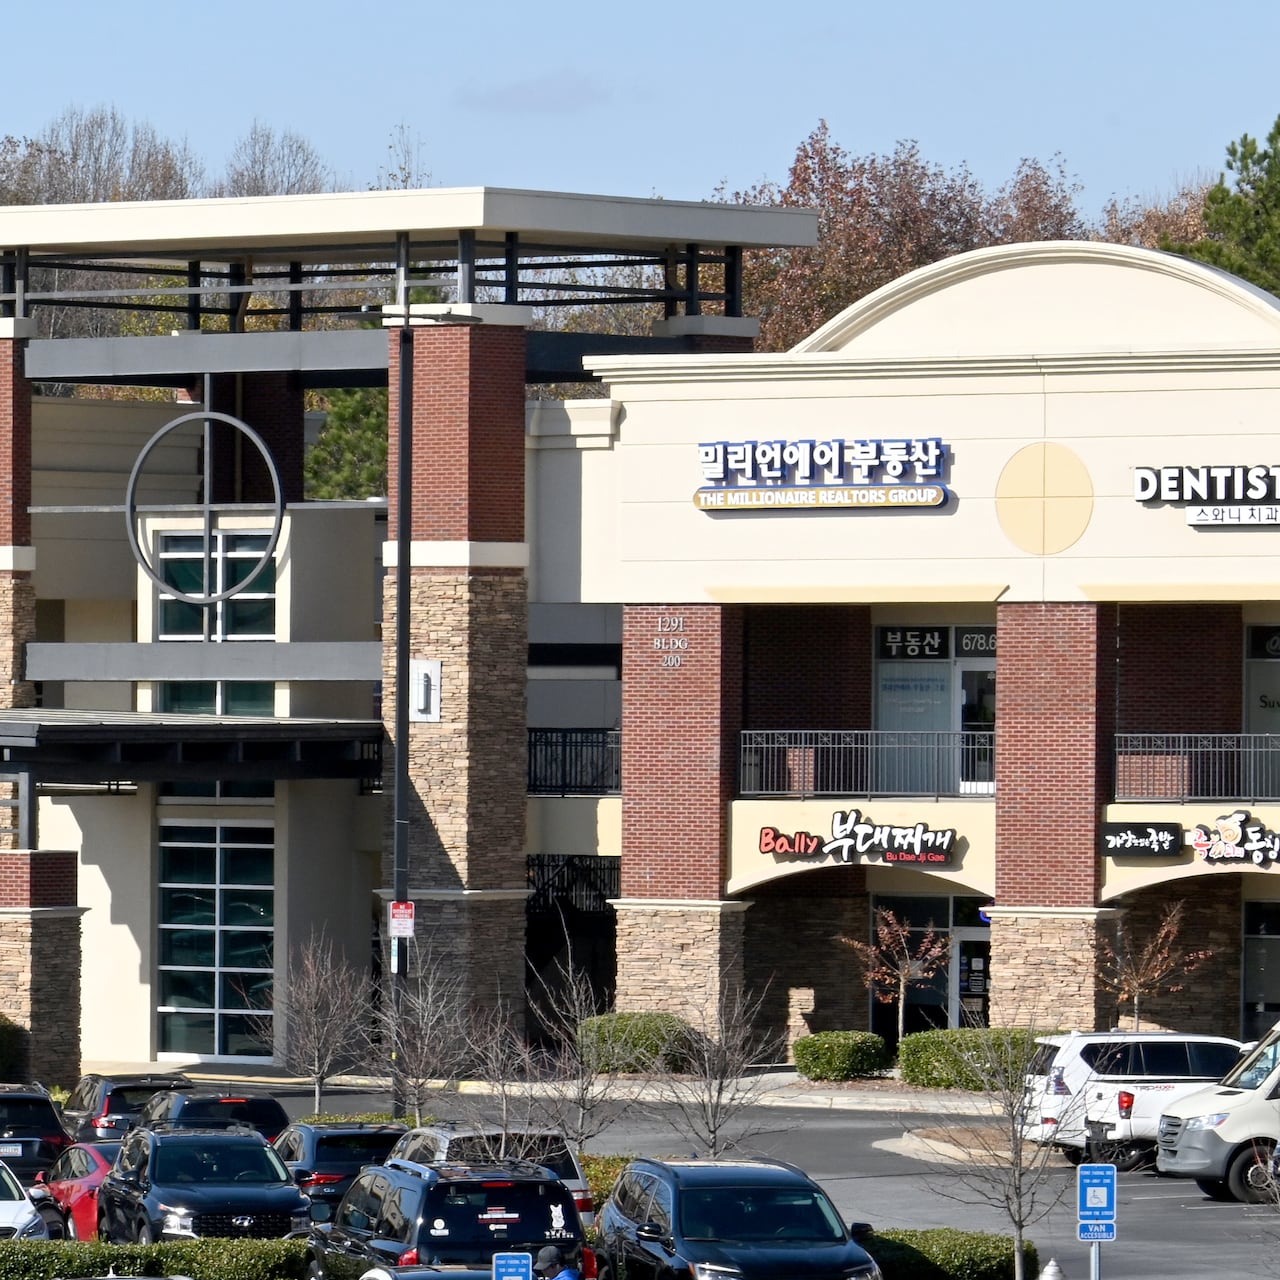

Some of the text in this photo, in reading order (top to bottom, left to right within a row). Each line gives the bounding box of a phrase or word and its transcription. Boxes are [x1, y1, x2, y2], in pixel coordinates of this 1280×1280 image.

[848, 439, 940, 477] 부동산
[699, 488, 938, 506] THE MILLIONAIRE REALTORS GROUP
[1196, 506, 1279, 523] 스와니 치과
[657, 617, 685, 632] 1291
[653, 638, 688, 650] BLDG
[886, 631, 940, 655] 부동산
[661, 656, 681, 667] 200
[760, 829, 818, 854] Bally
[822, 811, 952, 861] 부대찌개
[886, 852, 945, 863] Bu Dae Ji Gae
[1088, 1224, 1106, 1232] VAN
